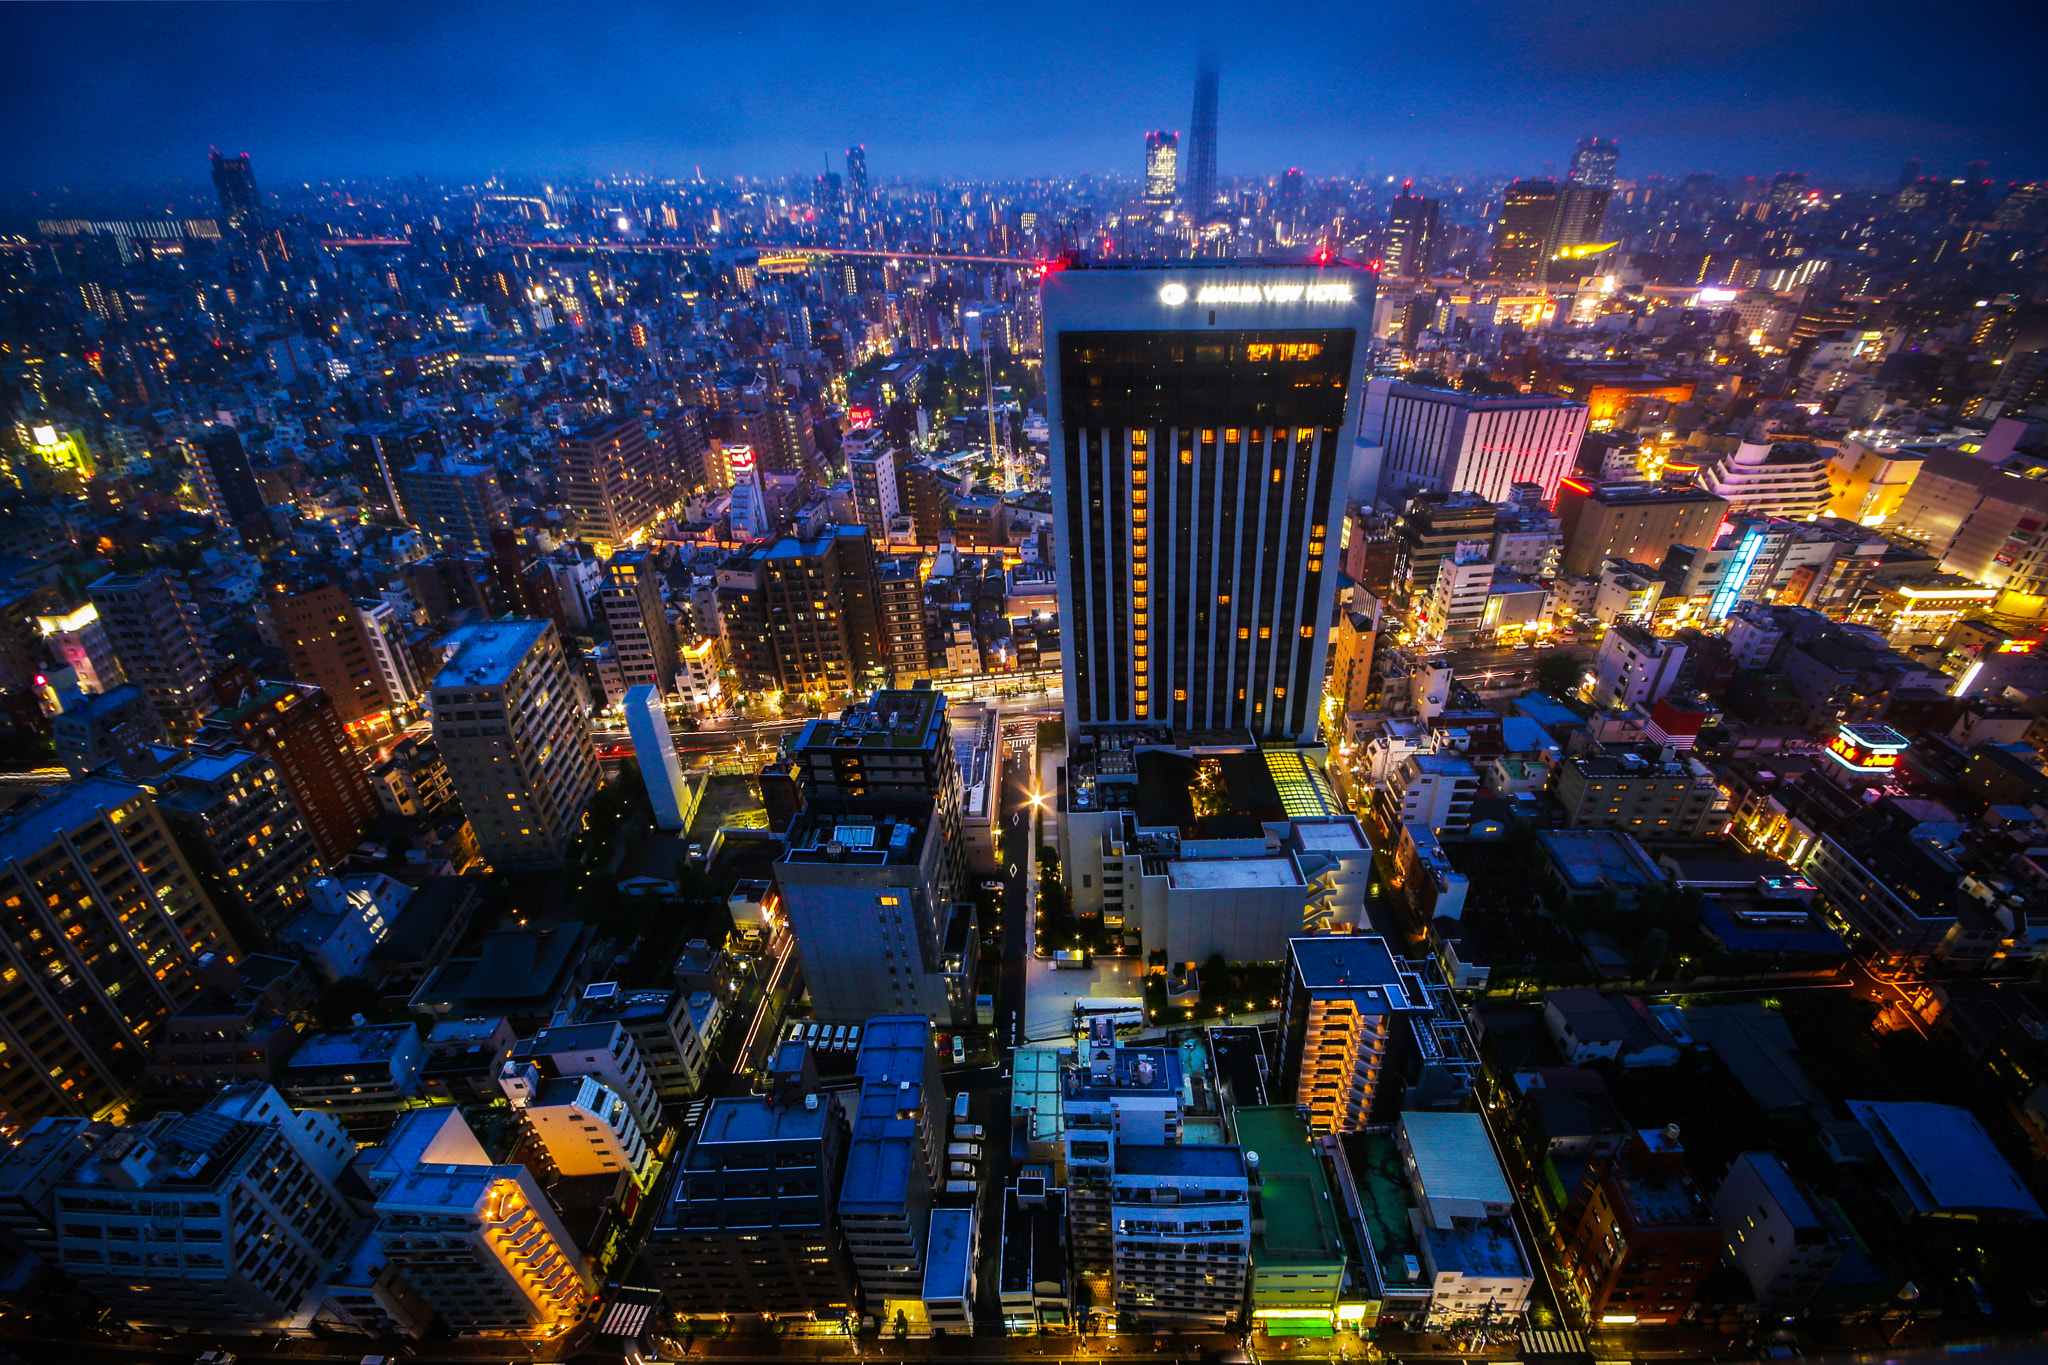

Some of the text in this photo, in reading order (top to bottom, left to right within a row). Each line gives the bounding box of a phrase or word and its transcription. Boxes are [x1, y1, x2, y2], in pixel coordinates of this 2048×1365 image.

[1197, 284, 1353, 302] ASAKUSA VIEW HOTEL
